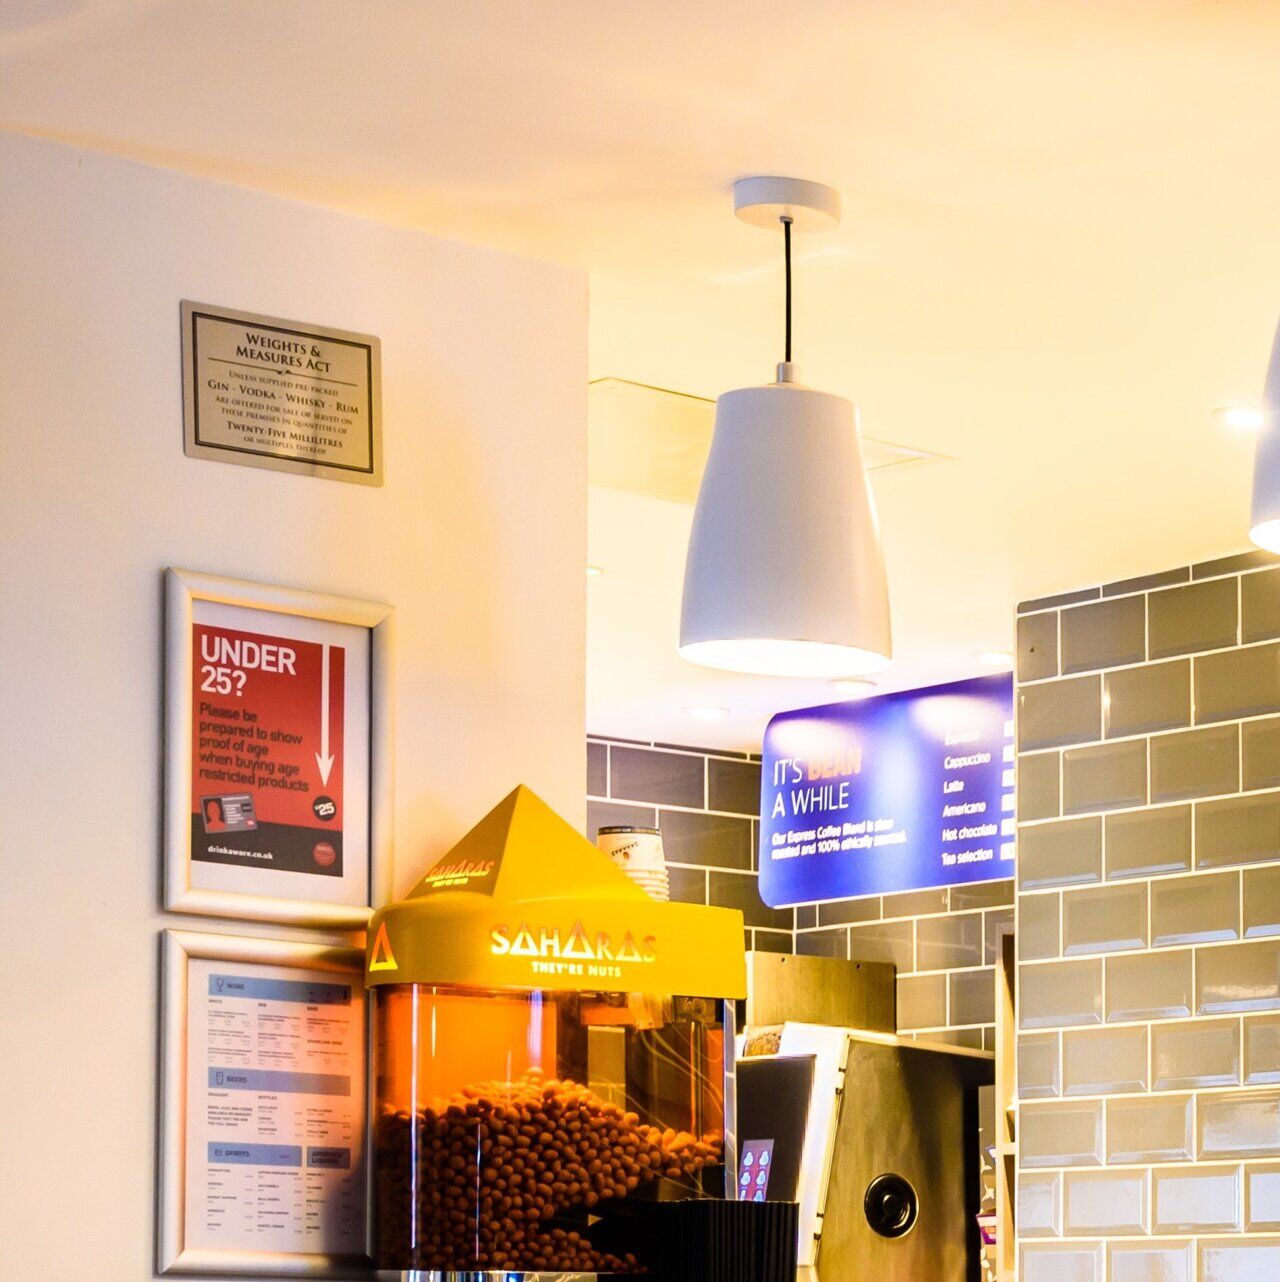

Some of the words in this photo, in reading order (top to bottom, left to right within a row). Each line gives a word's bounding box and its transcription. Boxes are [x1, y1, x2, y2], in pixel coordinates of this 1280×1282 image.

[246, 333, 307, 355] WEIGHTS
[311, 346, 321, 357] &
[236, 346, 302, 367] MEASURES
[306, 358, 331, 373] ACT
[229, 371, 257, 382] UNLESS
[259, 376, 293, 388] SUPPLIED
[208, 380, 229, 391] GIN
[240, 385, 275, 399] VODKA
[286, 393, 325, 409] WHISKY
[336, 402, 358, 414] RUM
[246, 411, 280, 423] PREMISES
[267, 405, 281, 413] FOR
[290, 430, 343, 448] MILLILITRES
[201, 635, 296, 675] UNDER
[201, 666, 246, 696] 25?
[200, 703, 240, 722] Please
[243, 709, 257, 723] be
[200, 721, 253, 741] prepared
[256, 727, 267, 740] to
[270, 730, 302, 745] show
[200, 737, 230, 755] proof
[232, 739, 244, 752] of
[247, 744, 268, 756] age
[200, 753, 232, 767] when
[235, 755, 274, 775] buying
[277, 761, 298, 776] age
[774, 757, 803, 786] IT'S
[807, 747, 862, 781] BEAN
[945, 753, 990, 769] Cappuccino
[200, 768, 255, 786] restricted
[258, 775, 309, 796] products
[943, 781, 964, 793] Latte
[772, 792, 785, 818] A
[791, 782, 849, 815] WHILE
[943, 801, 986, 817] Americano
[772, 833, 785, 846] Our
[817, 825, 841, 838] Coffee
[942, 829, 957, 841] Hot
[959, 824, 997, 839] chocolate
[208, 844, 273, 861] drinkaware.co.uk
[801, 843, 816, 855] and
[818, 840, 840, 853] 100%
[942, 852, 955, 865] Tea
[957, 848, 993, 864] selection
[425, 858, 495, 883] SAHARAS
[491, 919, 657, 963] SAHARAS
[531, 961, 583, 975] THEY'RE
[588, 964, 621, 977] NUTS
